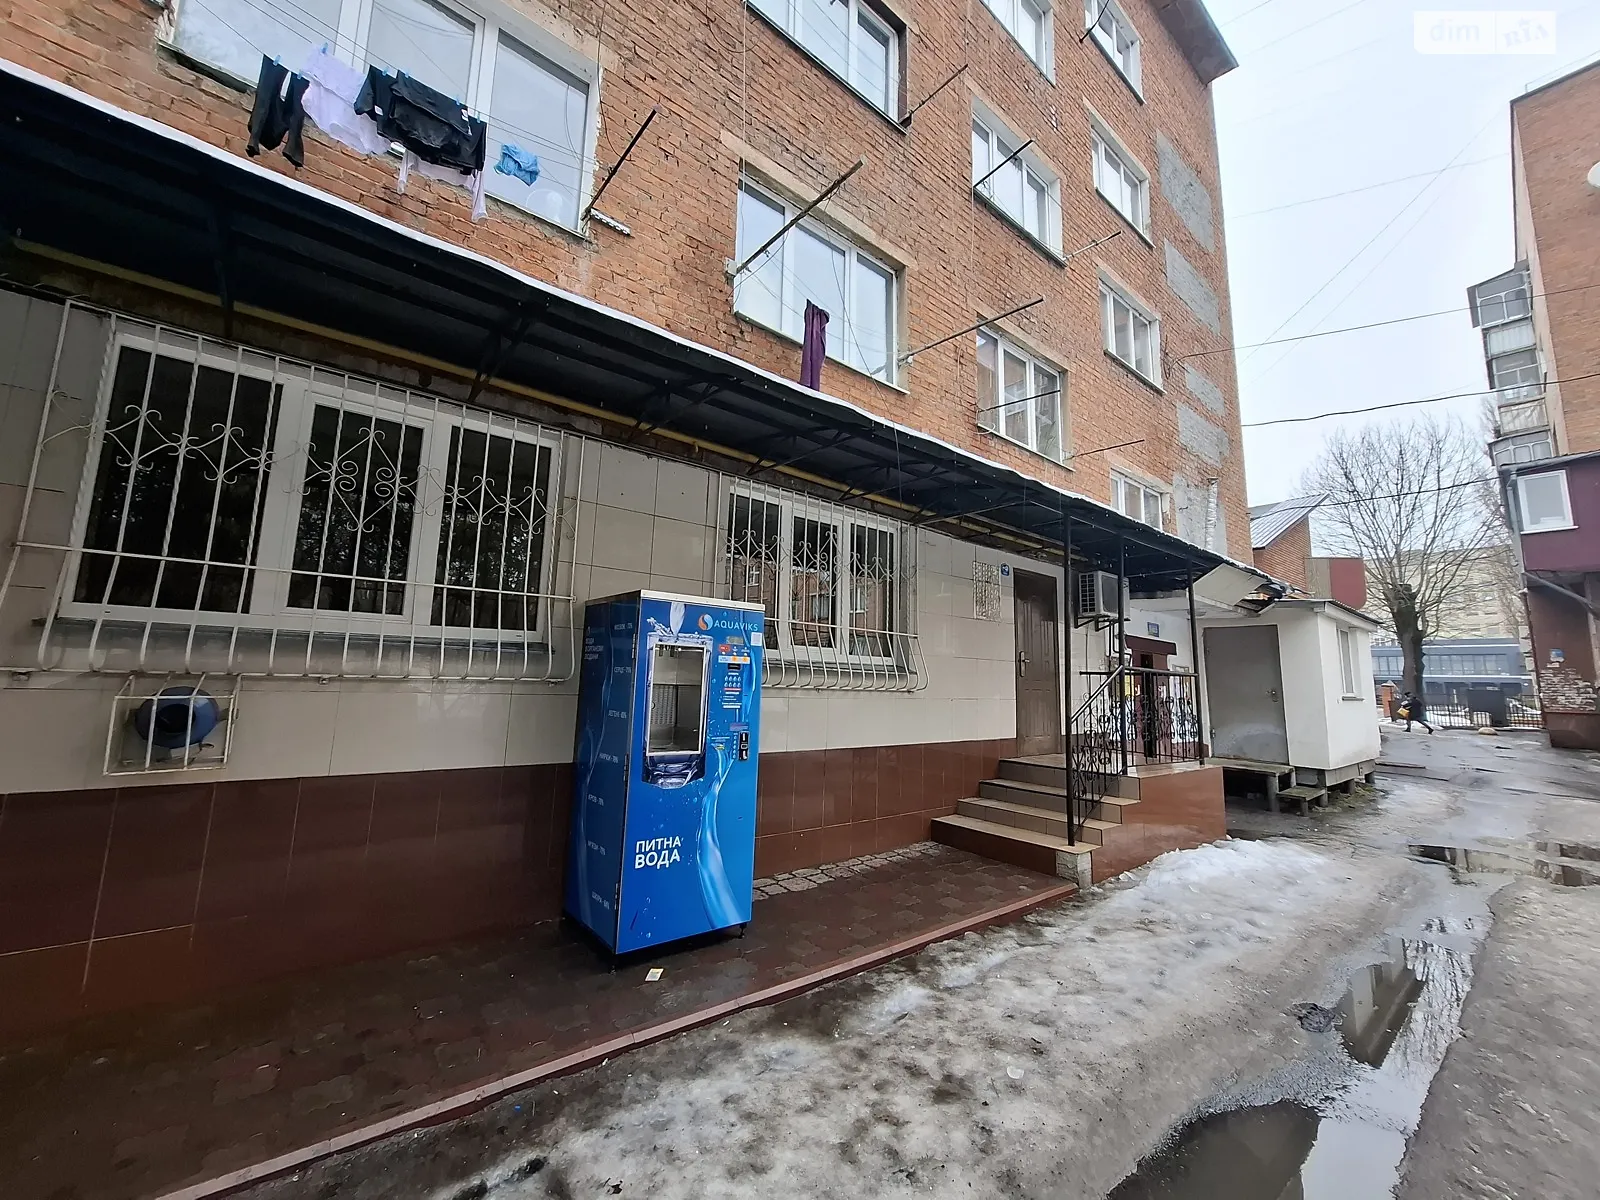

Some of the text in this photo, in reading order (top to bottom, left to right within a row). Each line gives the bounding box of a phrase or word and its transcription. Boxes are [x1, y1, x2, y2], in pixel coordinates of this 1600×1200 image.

[714, 619, 759, 632] AQUAVIKS
[635, 835, 682, 854] ПИТНА
[634, 848, 681, 870] ВОДА
